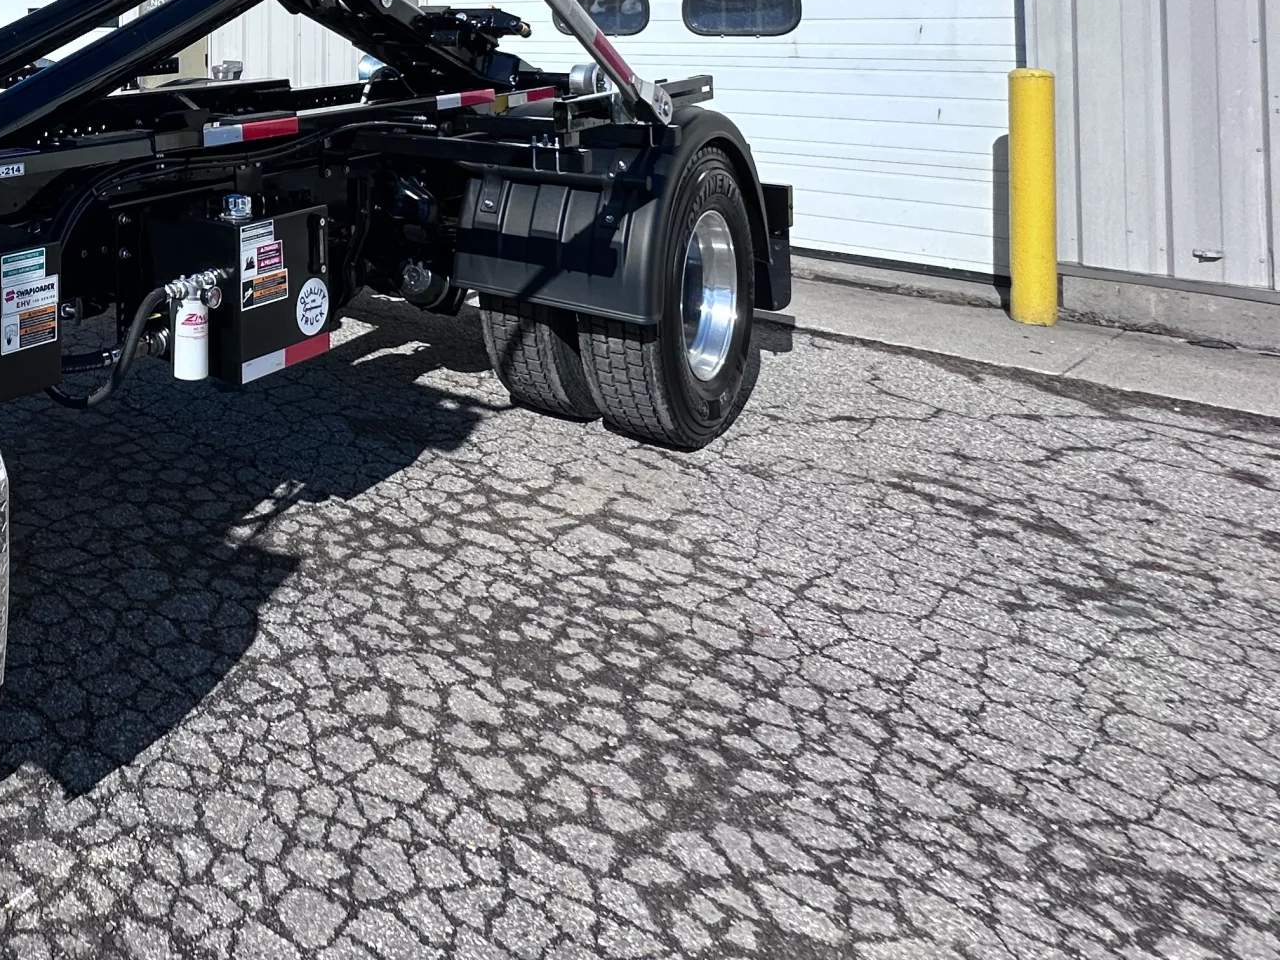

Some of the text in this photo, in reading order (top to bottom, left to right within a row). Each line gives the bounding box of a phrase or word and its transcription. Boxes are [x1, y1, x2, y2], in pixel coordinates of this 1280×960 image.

[16, 283, 55, 299] SWAPLOADER
[299, 286, 326, 305] QUALITY
[300, 311, 325, 327] TRUCK
